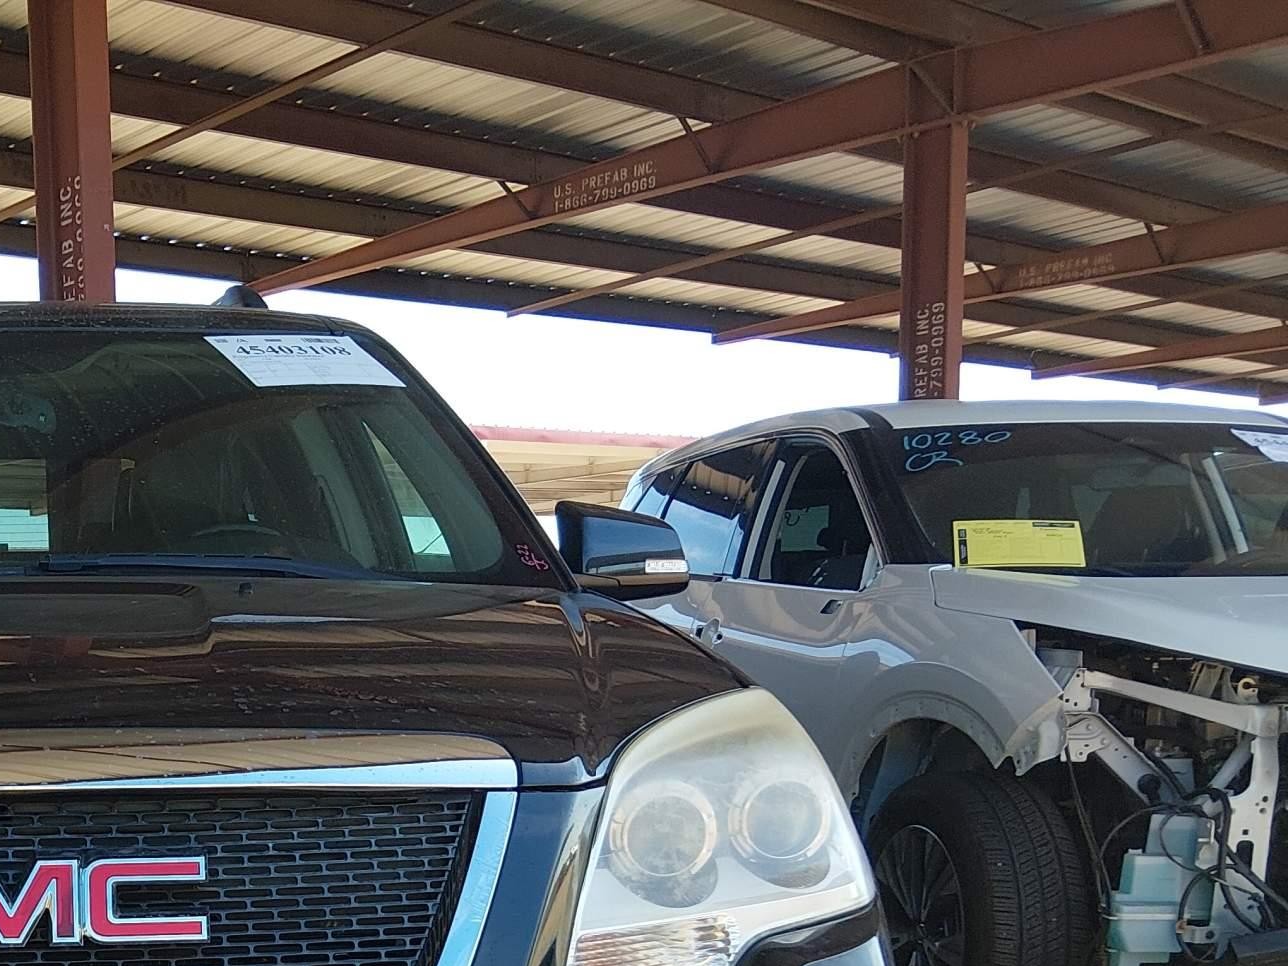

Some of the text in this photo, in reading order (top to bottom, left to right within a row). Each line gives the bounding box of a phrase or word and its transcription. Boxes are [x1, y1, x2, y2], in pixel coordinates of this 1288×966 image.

[553, 160, 657, 198] U.S. PREFAB INC.
[554, 176, 656, 213] 1-866-799-0969
[59, 177, 72, 226] INC.
[235, 345, 352, 356] 45403108
[914, 303, 930, 398] REFAB INC.
[903, 430, 1012, 450] 10280
